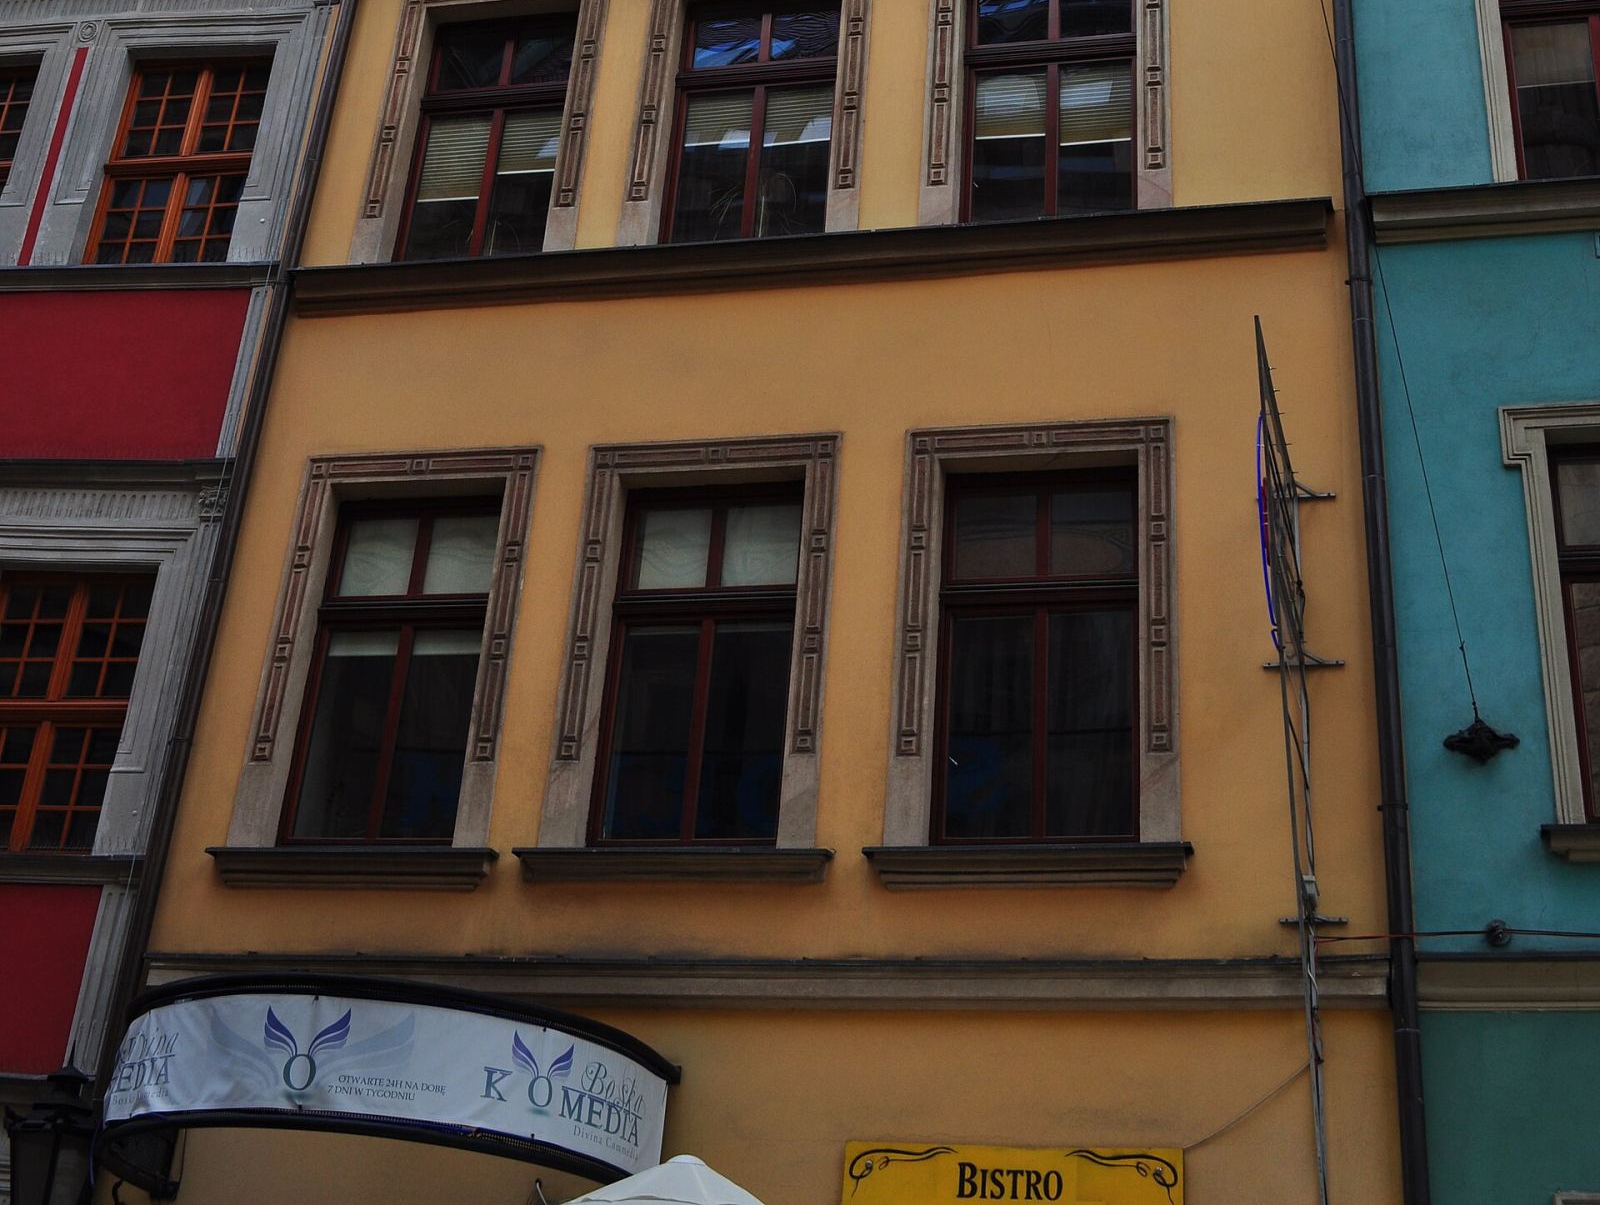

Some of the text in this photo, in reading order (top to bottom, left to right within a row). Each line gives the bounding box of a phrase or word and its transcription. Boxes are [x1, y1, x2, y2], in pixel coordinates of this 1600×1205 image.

[327, 1084, 416, 1101] 7 DNI W TYGODNIU
[338, 1074, 447, 1096] OTWARTE 24H NA DOBĘ
